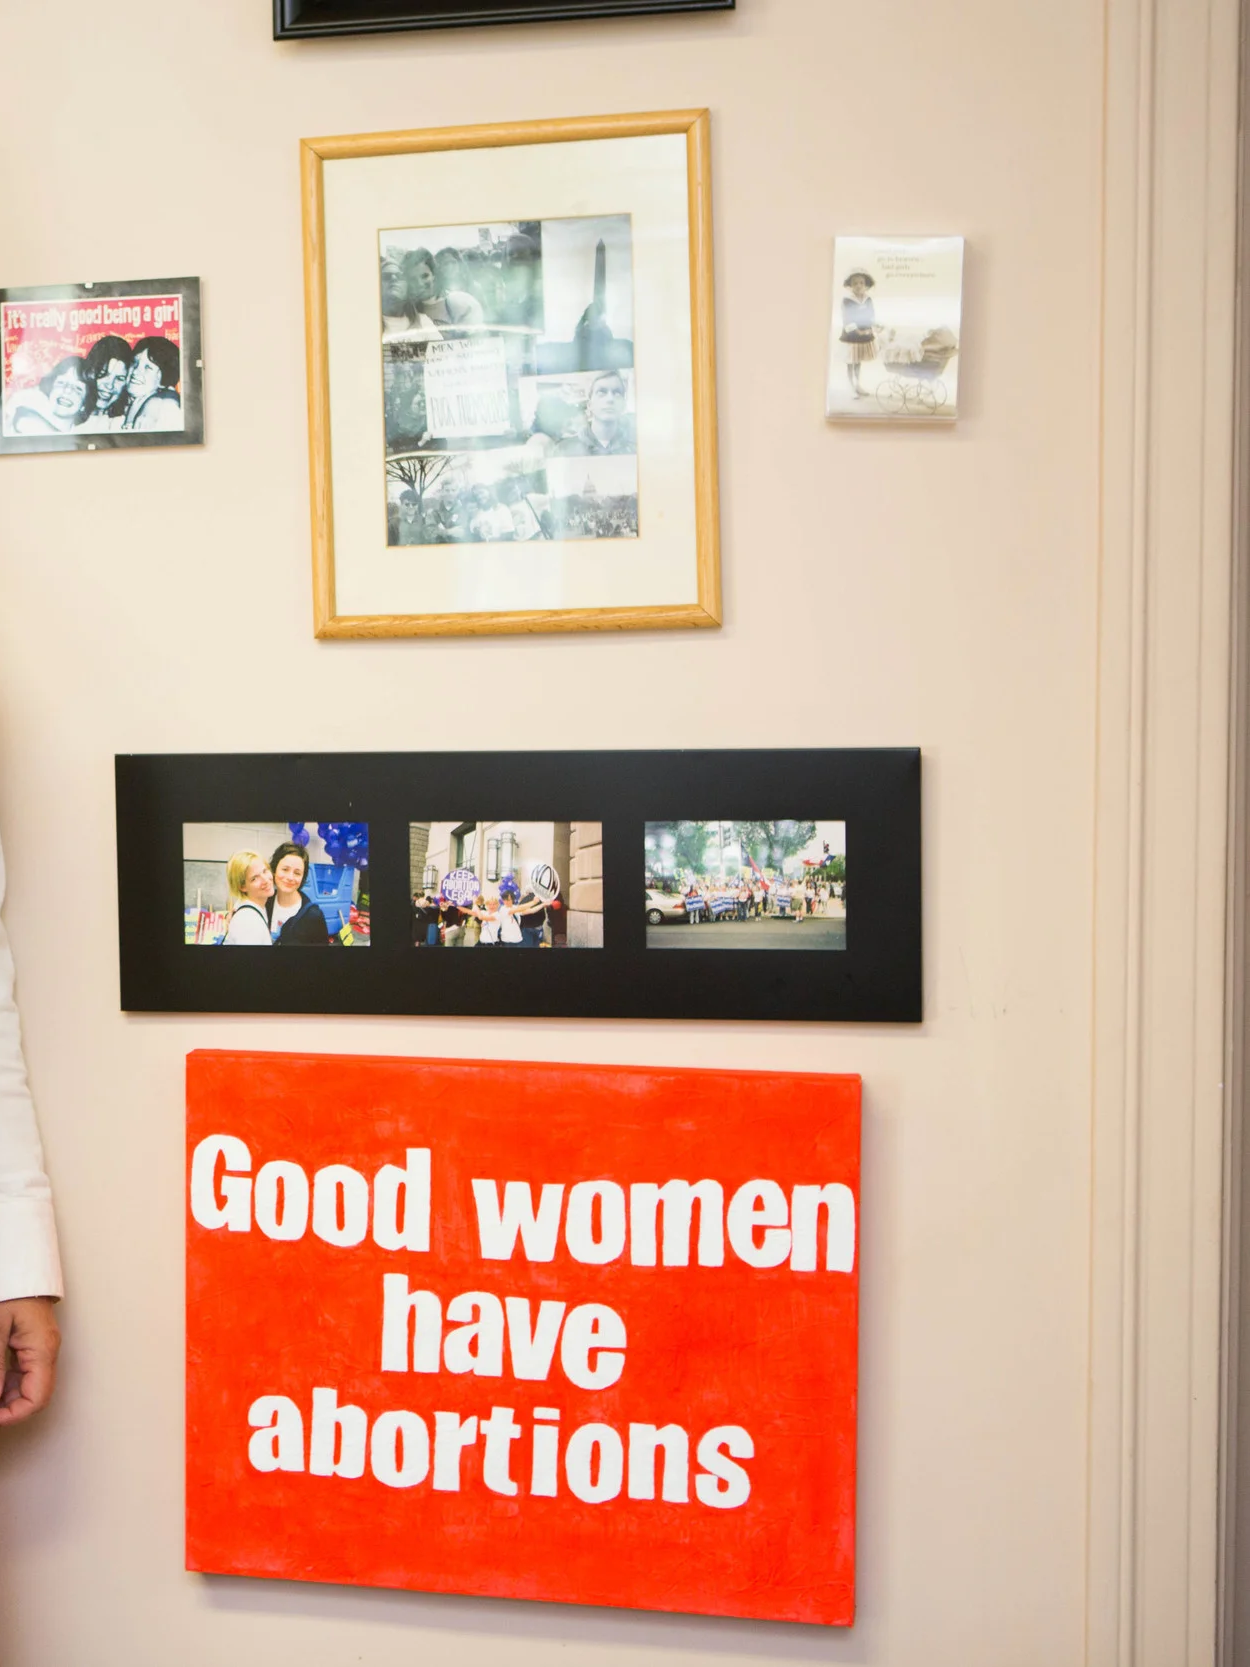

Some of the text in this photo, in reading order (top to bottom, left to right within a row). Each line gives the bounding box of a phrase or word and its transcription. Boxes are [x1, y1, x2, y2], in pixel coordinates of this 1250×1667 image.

[7, 300, 180, 332] It's really good being a girl
[450, 870, 475, 880] KEEP
[191, 1134, 856, 1273] Good women
[381, 1273, 627, 1390] have
[248, 1387, 755, 1509] abortions
